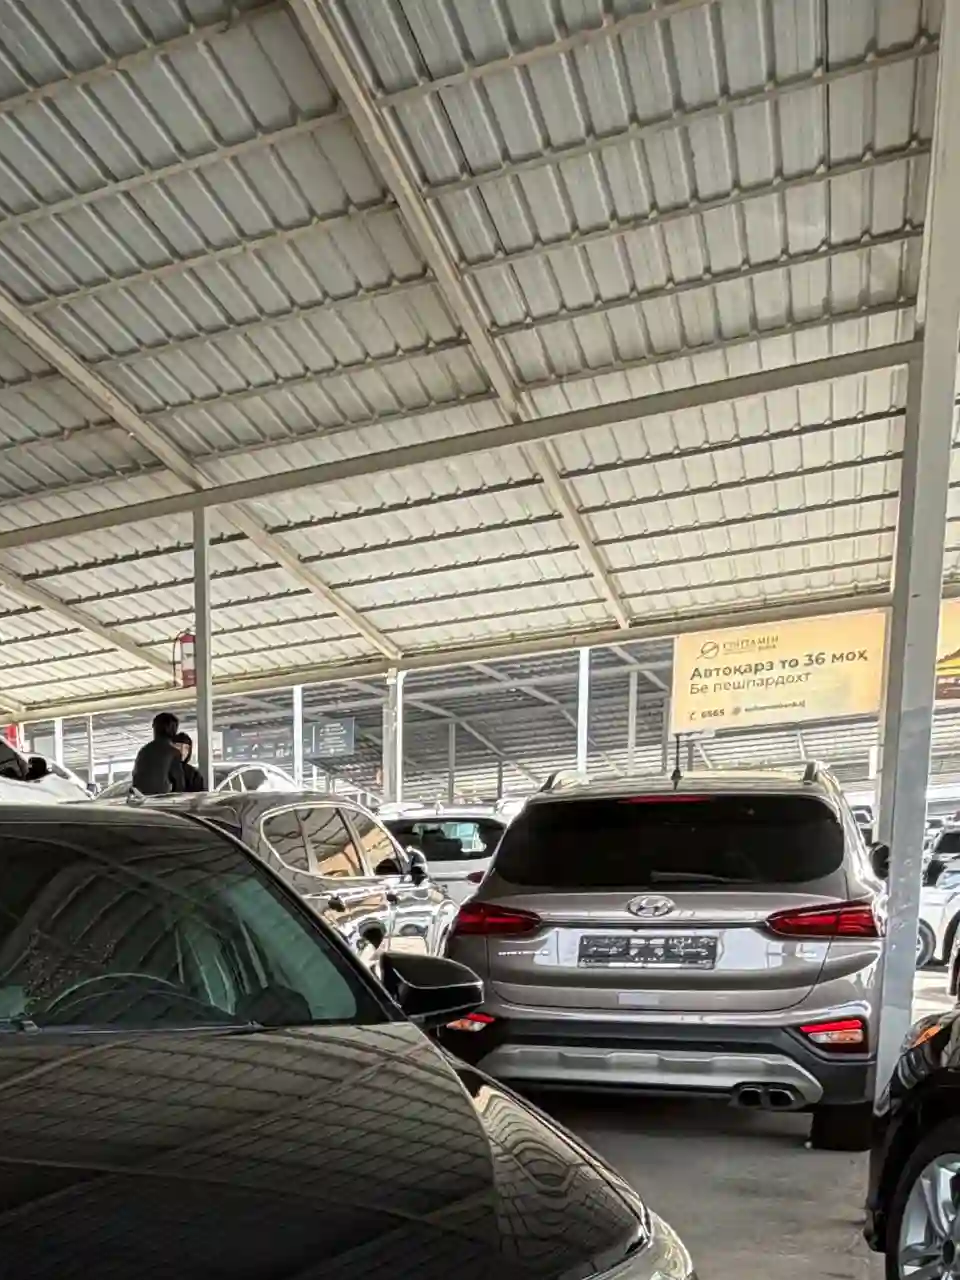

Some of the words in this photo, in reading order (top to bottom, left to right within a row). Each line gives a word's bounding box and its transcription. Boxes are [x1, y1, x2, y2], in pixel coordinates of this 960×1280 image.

[779, 657, 800, 670] то
[803, 652, 826, 667] 36
[831, 649, 869, 664] моҳ
[690, 682, 709, 695] Бе
[713, 671, 812, 691] пешпардохт
